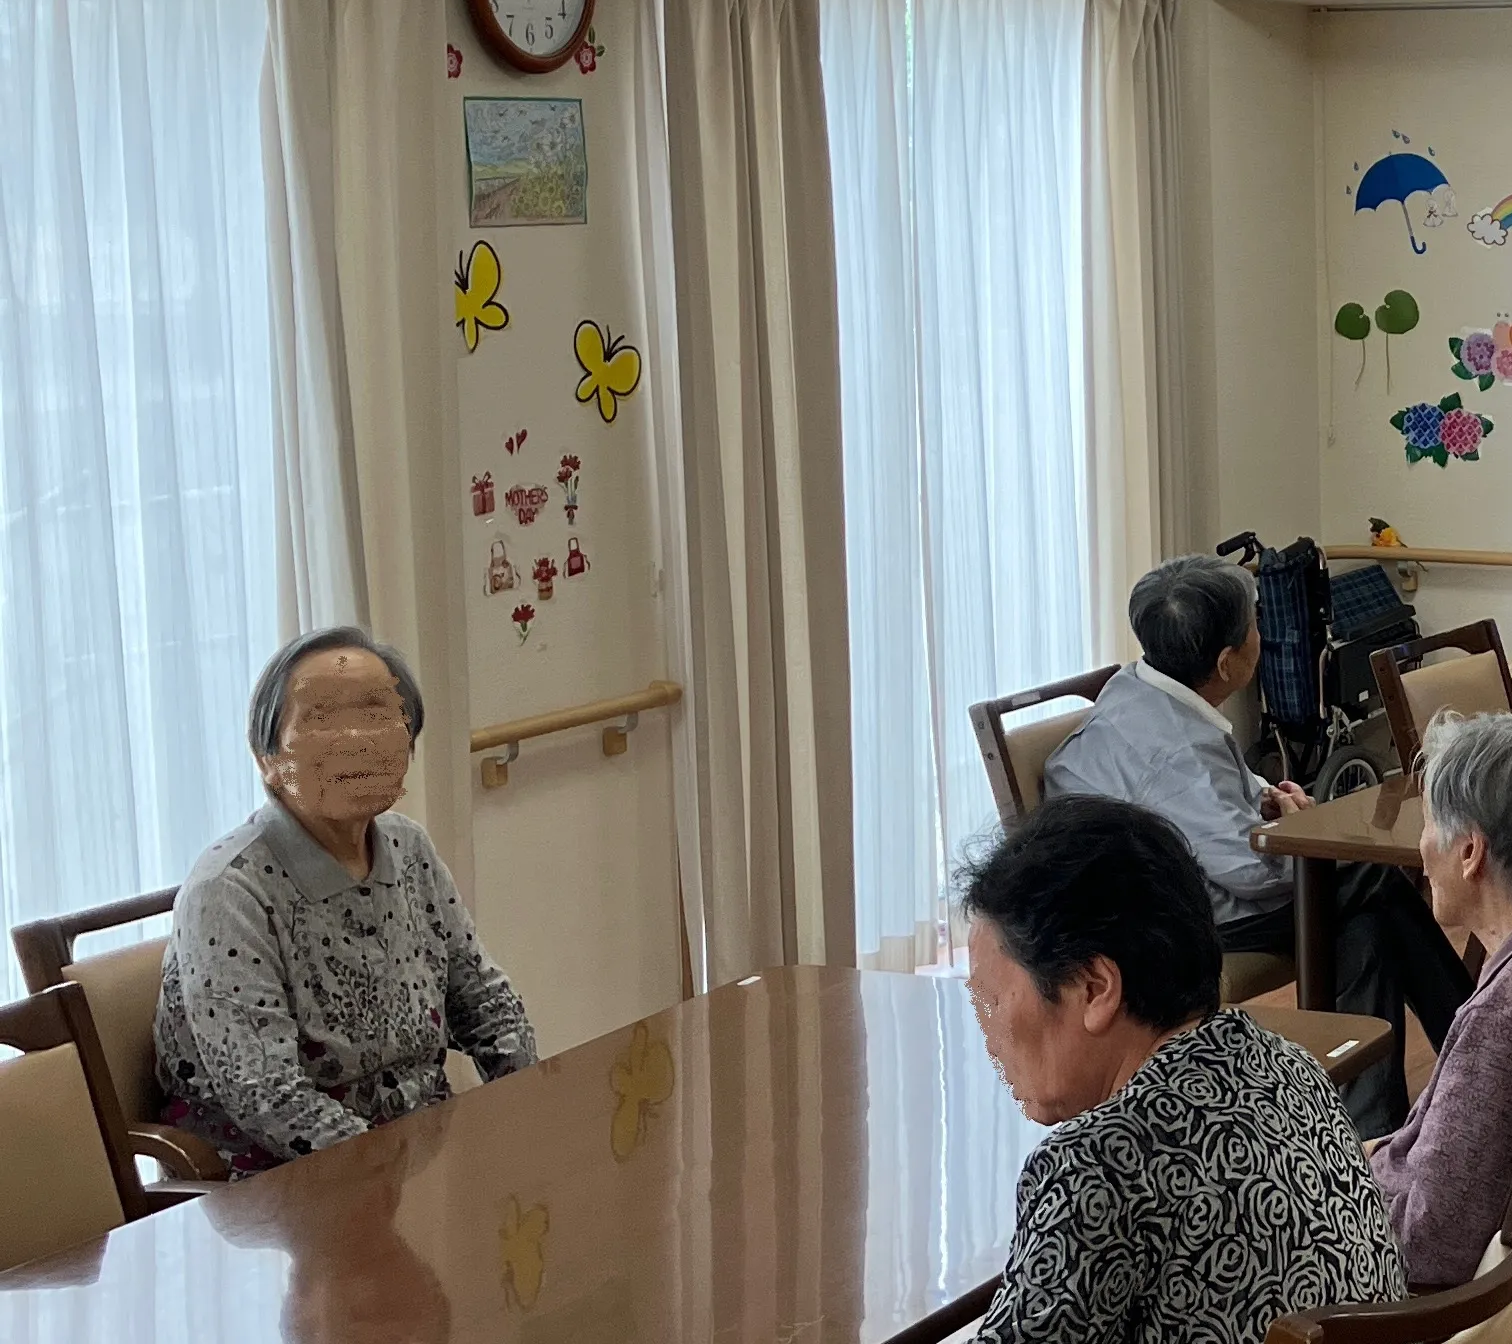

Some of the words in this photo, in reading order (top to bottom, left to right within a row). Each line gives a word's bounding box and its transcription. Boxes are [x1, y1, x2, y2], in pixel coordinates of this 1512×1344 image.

[506, 14, 514, 37] 7
[525, 23, 535, 46] 6
[545, 17, 554, 39] 5
[518, 507, 538, 525] DAY
